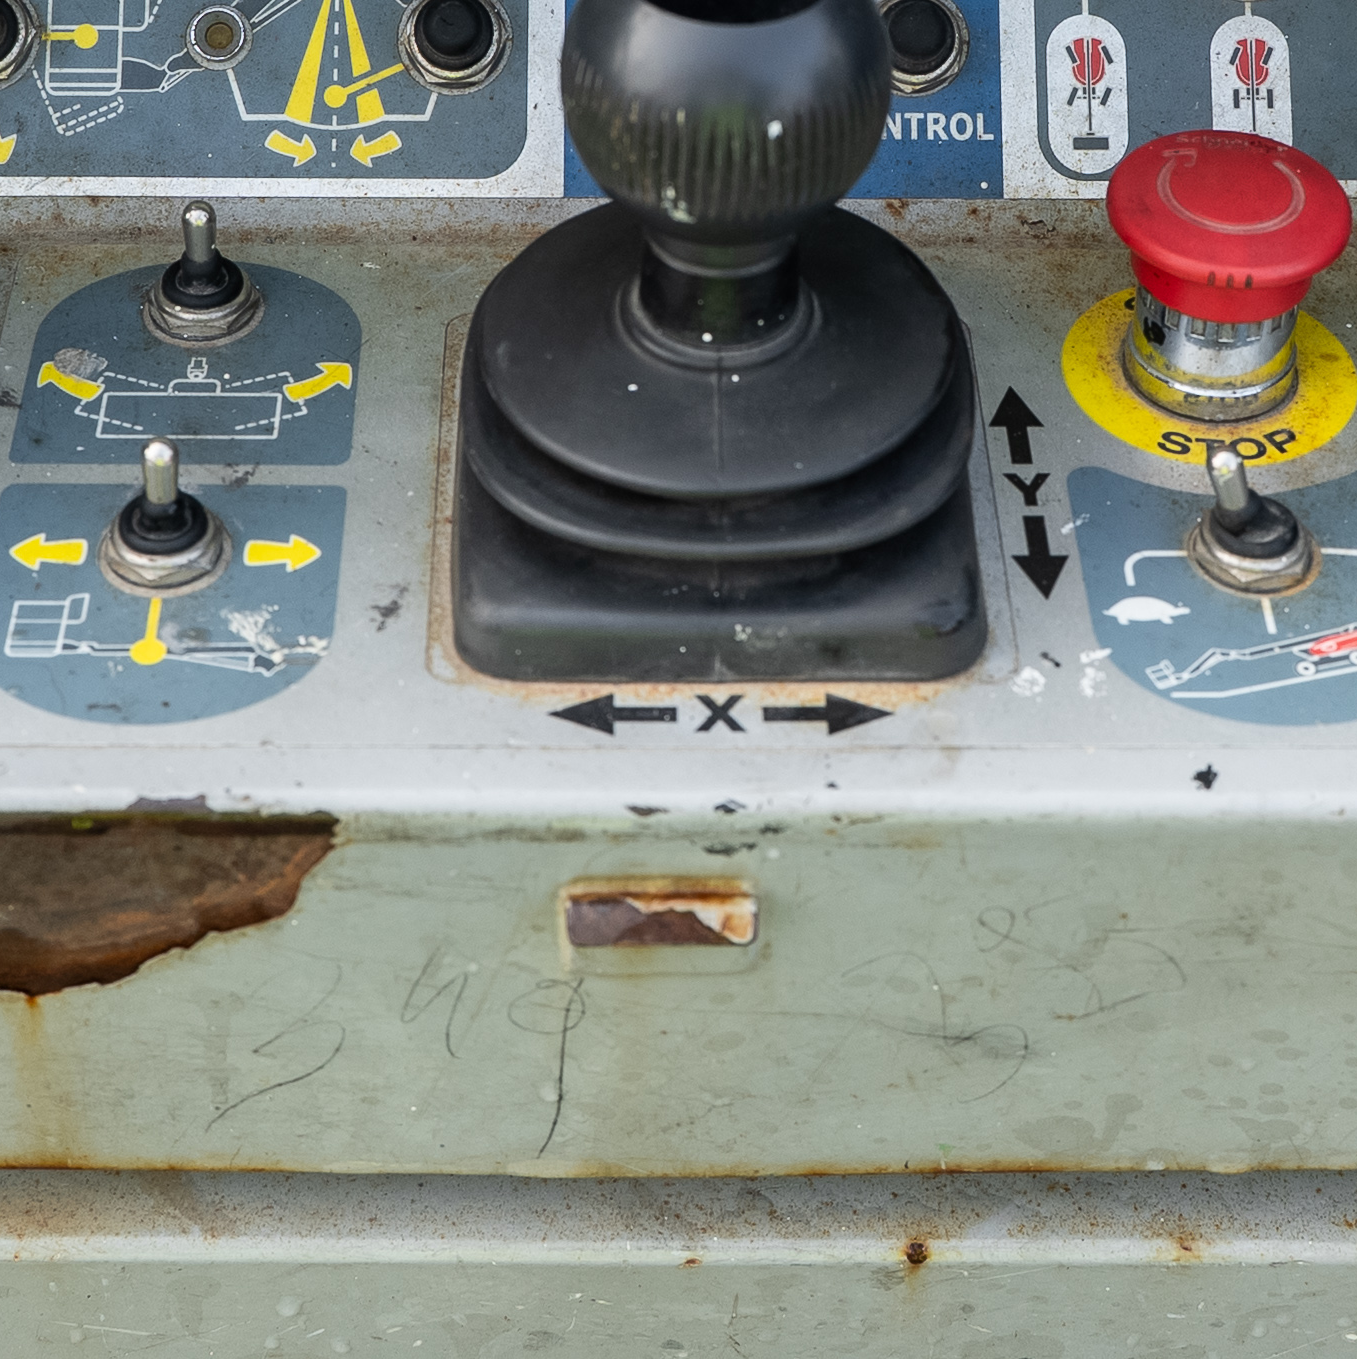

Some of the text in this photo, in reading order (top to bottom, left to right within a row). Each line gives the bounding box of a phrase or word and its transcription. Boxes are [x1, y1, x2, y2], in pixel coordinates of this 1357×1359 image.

[881, 112, 994, 141] NTROL
[1002, 472, 1051, 507] Y
[695, 694, 746, 732] X
